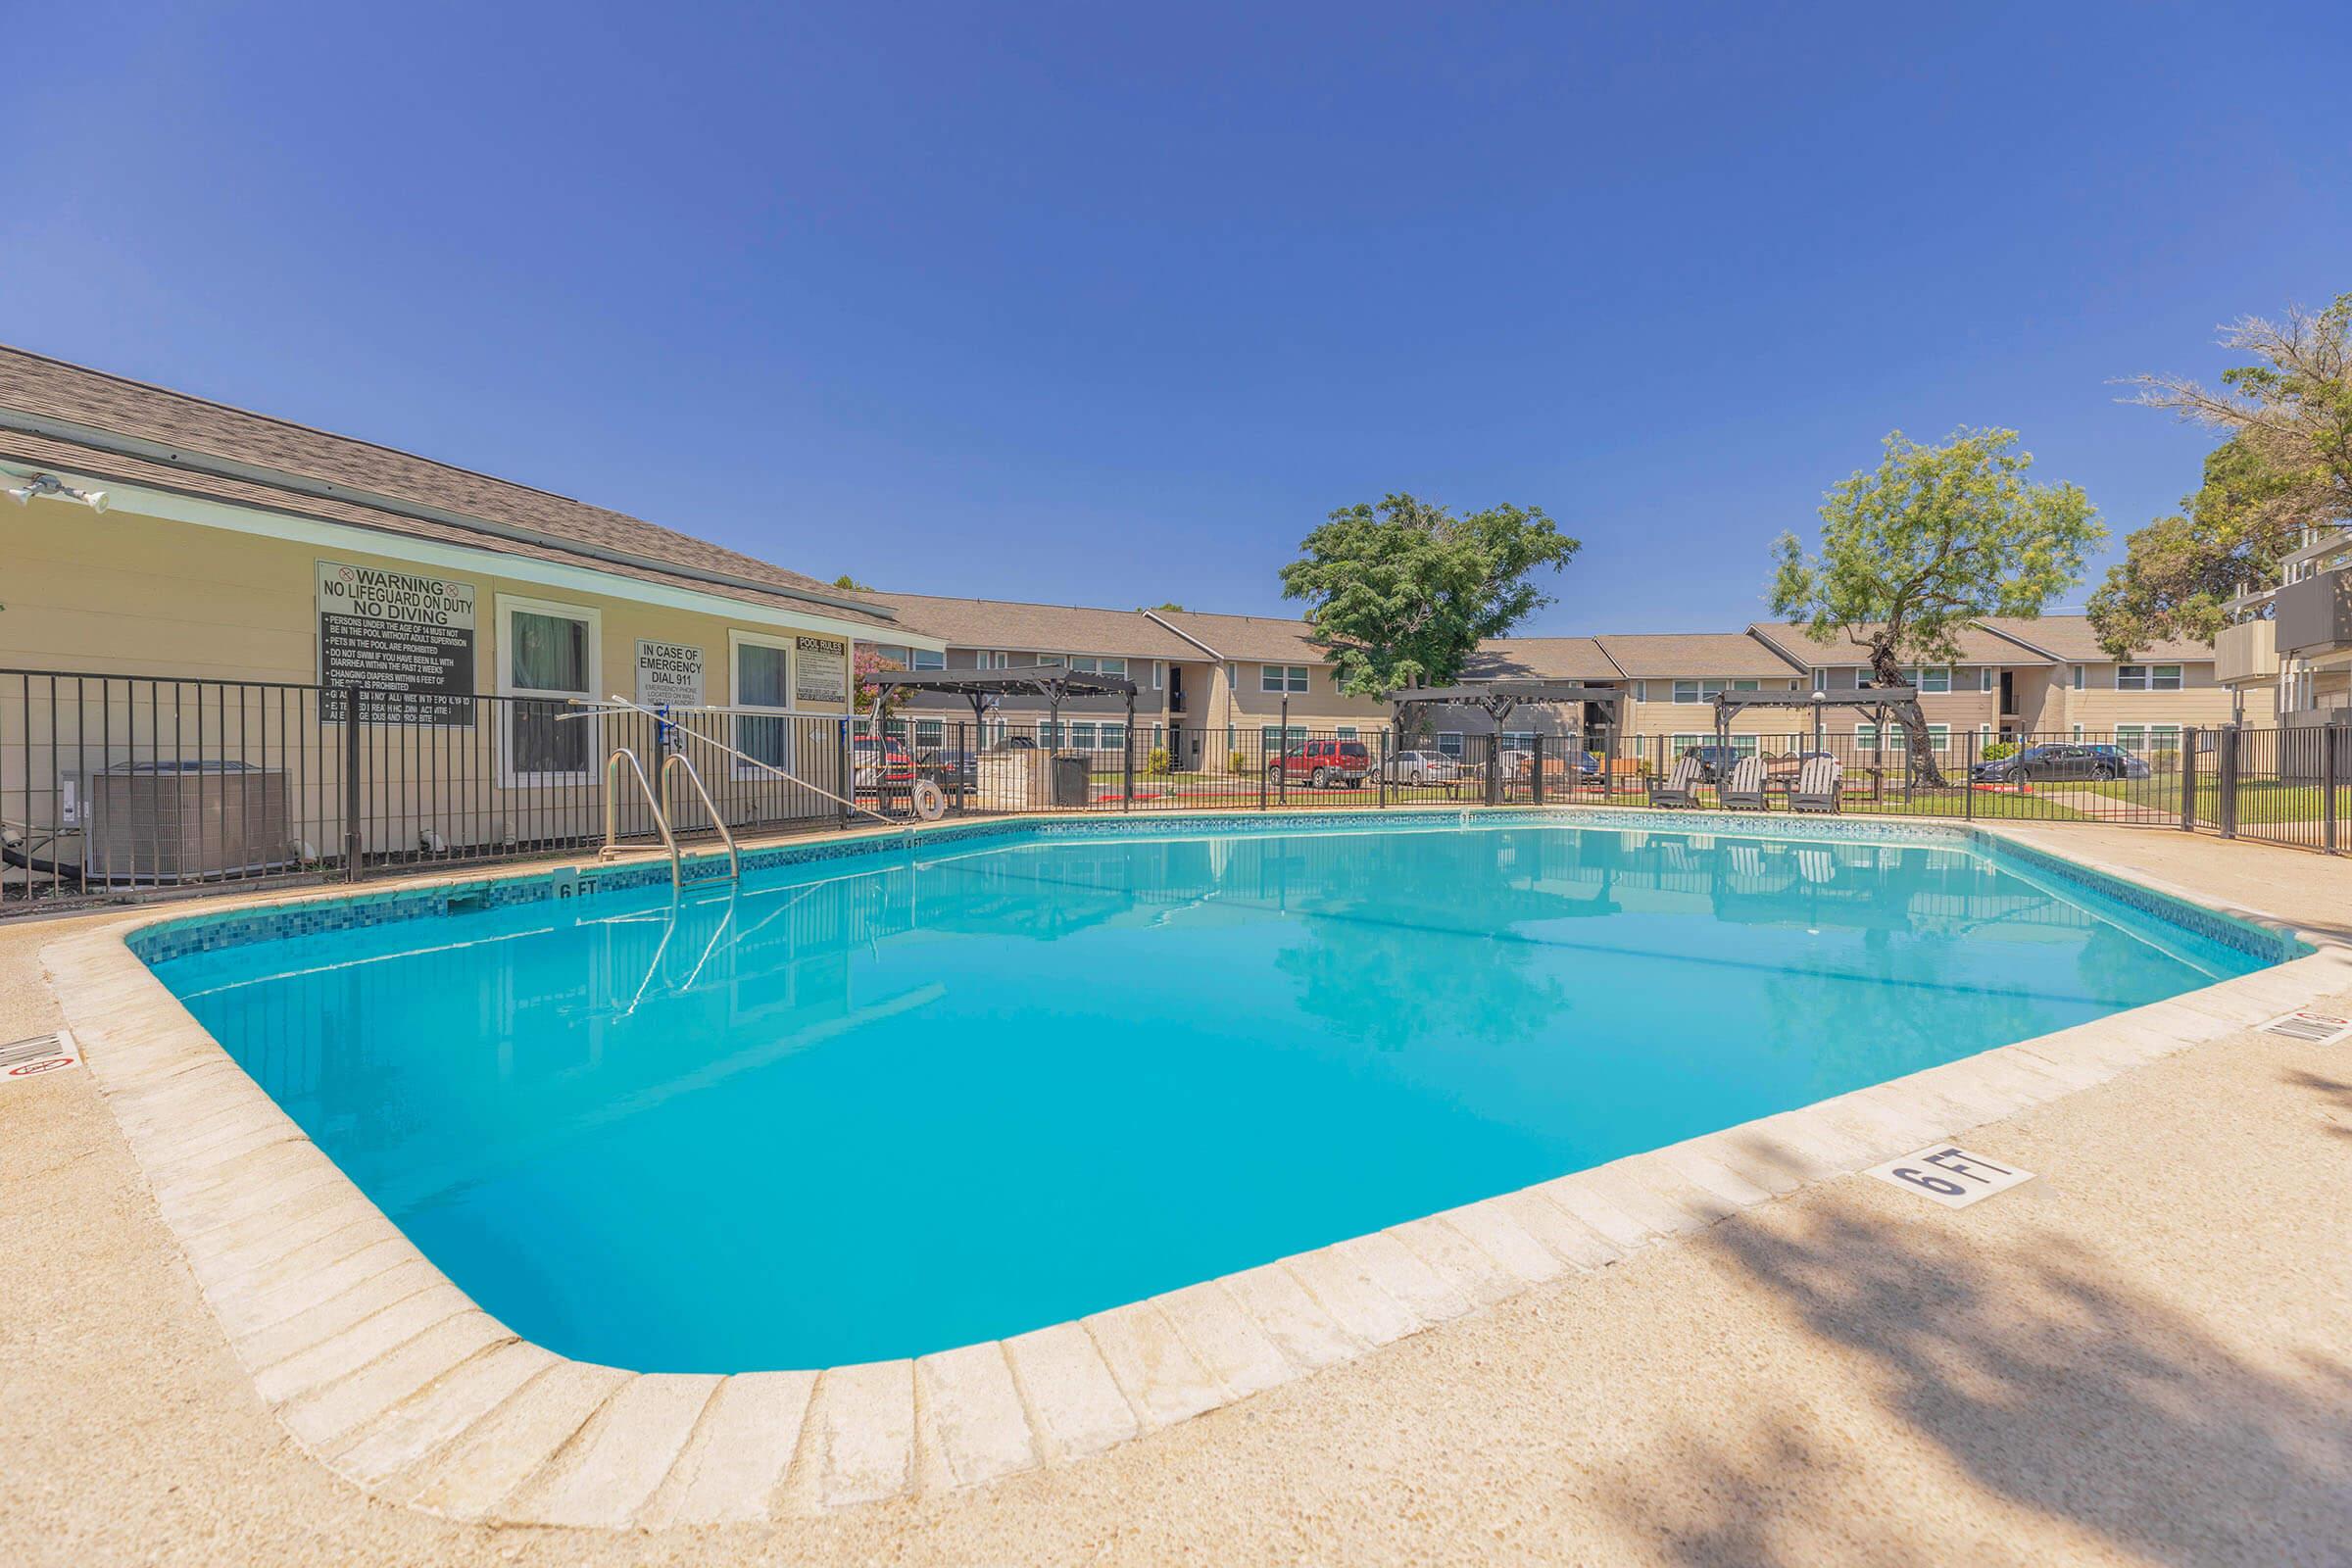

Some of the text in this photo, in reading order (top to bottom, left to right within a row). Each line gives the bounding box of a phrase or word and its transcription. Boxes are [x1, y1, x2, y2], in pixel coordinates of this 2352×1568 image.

[357, 569, 444, 595] WARNING
[324, 580, 472, 614] NO LIFEGUARD ON DUTY
[354, 601, 448, 625] NO DIVING
[330, 617, 362, 627] PERSONS
[363, 620, 385, 629] UNDER
[330, 625, 340, 633] BE
[349, 627, 362, 635] THE
[363, 629, 381, 638] POOL
[382, 631, 409, 641] WITHOUT
[411, 634, 429, 643] ADULT
[431, 636, 467, 647] SUPERVISION
[330, 637, 438, 654] PETS IN THE POOL ARE PROHIBITED
[643, 644, 698, 660] IN CASE OF
[800, 638, 819, 648] POOL
[820, 641, 841, 651] RULES
[330, 649, 341, 657] DO
[342, 650, 356, 658] NOT
[357, 651, 374, 659] SWIM
[382, 653, 395, 661] YOU
[397, 654, 413, 663] HAVE
[414, 656, 429, 664] BEEN
[440, 658, 454, 666] WITH
[641, 658, 701, 673] EMERGENCY
[331, 658, 365, 668] DIARRHEA
[365, 660, 387, 669] WITHIN
[402, 663, 417, 672] PAST
[422, 665, 443, 674] WEEKS
[330, 678, 344, 687] THE
[372, 681, 409, 691] PROHIBITED
[331, 670, 366, 680] CHANGING
[367, 673, 393, 682] DIAPERS
[395, 674, 416, 683] WITHIN
[652, 672, 690, 685] DIAL 911
[387, 713, 400, 721] AND
[560, 880, 596, 899] 6 FT
[1892, 1148, 2012, 1196] 6 FT
